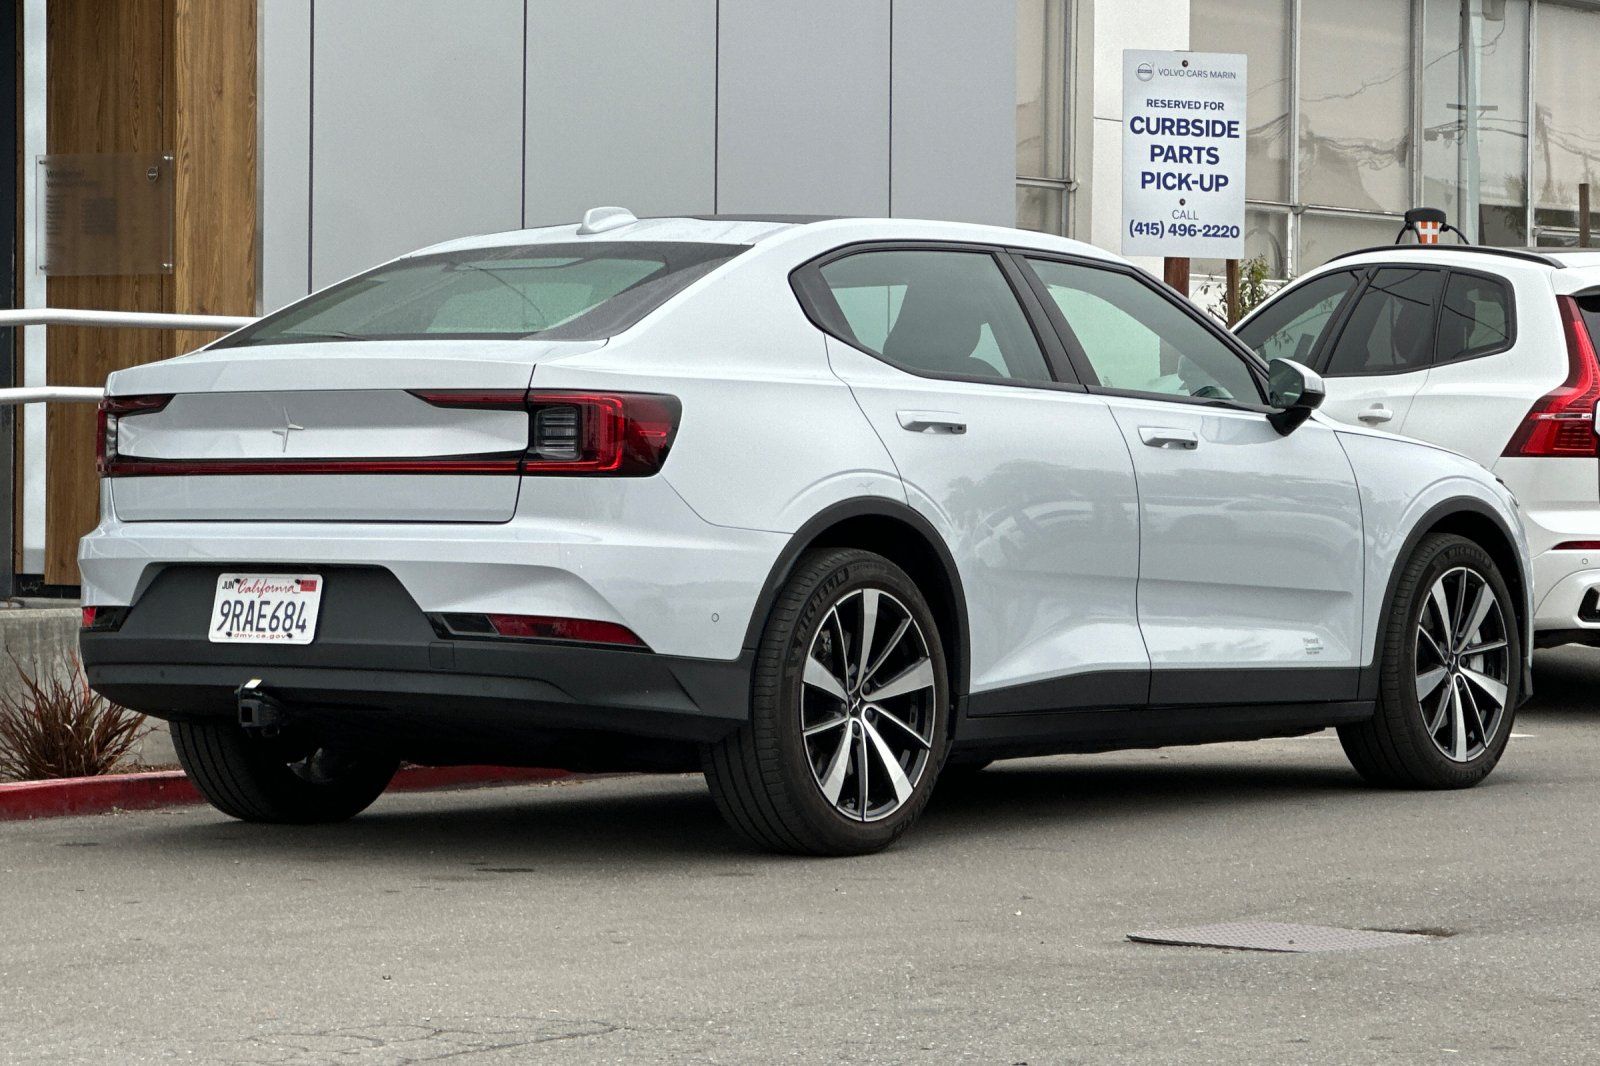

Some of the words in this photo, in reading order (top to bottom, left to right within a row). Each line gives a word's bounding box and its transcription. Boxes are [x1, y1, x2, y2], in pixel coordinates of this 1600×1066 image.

[1158, 68, 1186, 77] VOLVO
[1186, 70, 1209, 79] CARS
[1209, 71, 1237, 80] MARIN
[1146, 98, 1201, 110] RESERVED
[1203, 101, 1225, 111] FOR
[1129, 115, 1240, 139] CURBSIDE
[1150, 144, 1220, 165] PARTS
[1141, 171, 1229, 192] PICK-UP
[1171, 209, 1199, 221] CALL
[1129, 219, 1165, 239] (415)
[1167, 223, 1240, 239] 496-2220
[222, 580, 235, 590] JUN
[237, 578, 300, 598] California
[216, 599, 307, 633] 9RAE684
[233, 632, 287, 640] dmv.ca.gov
